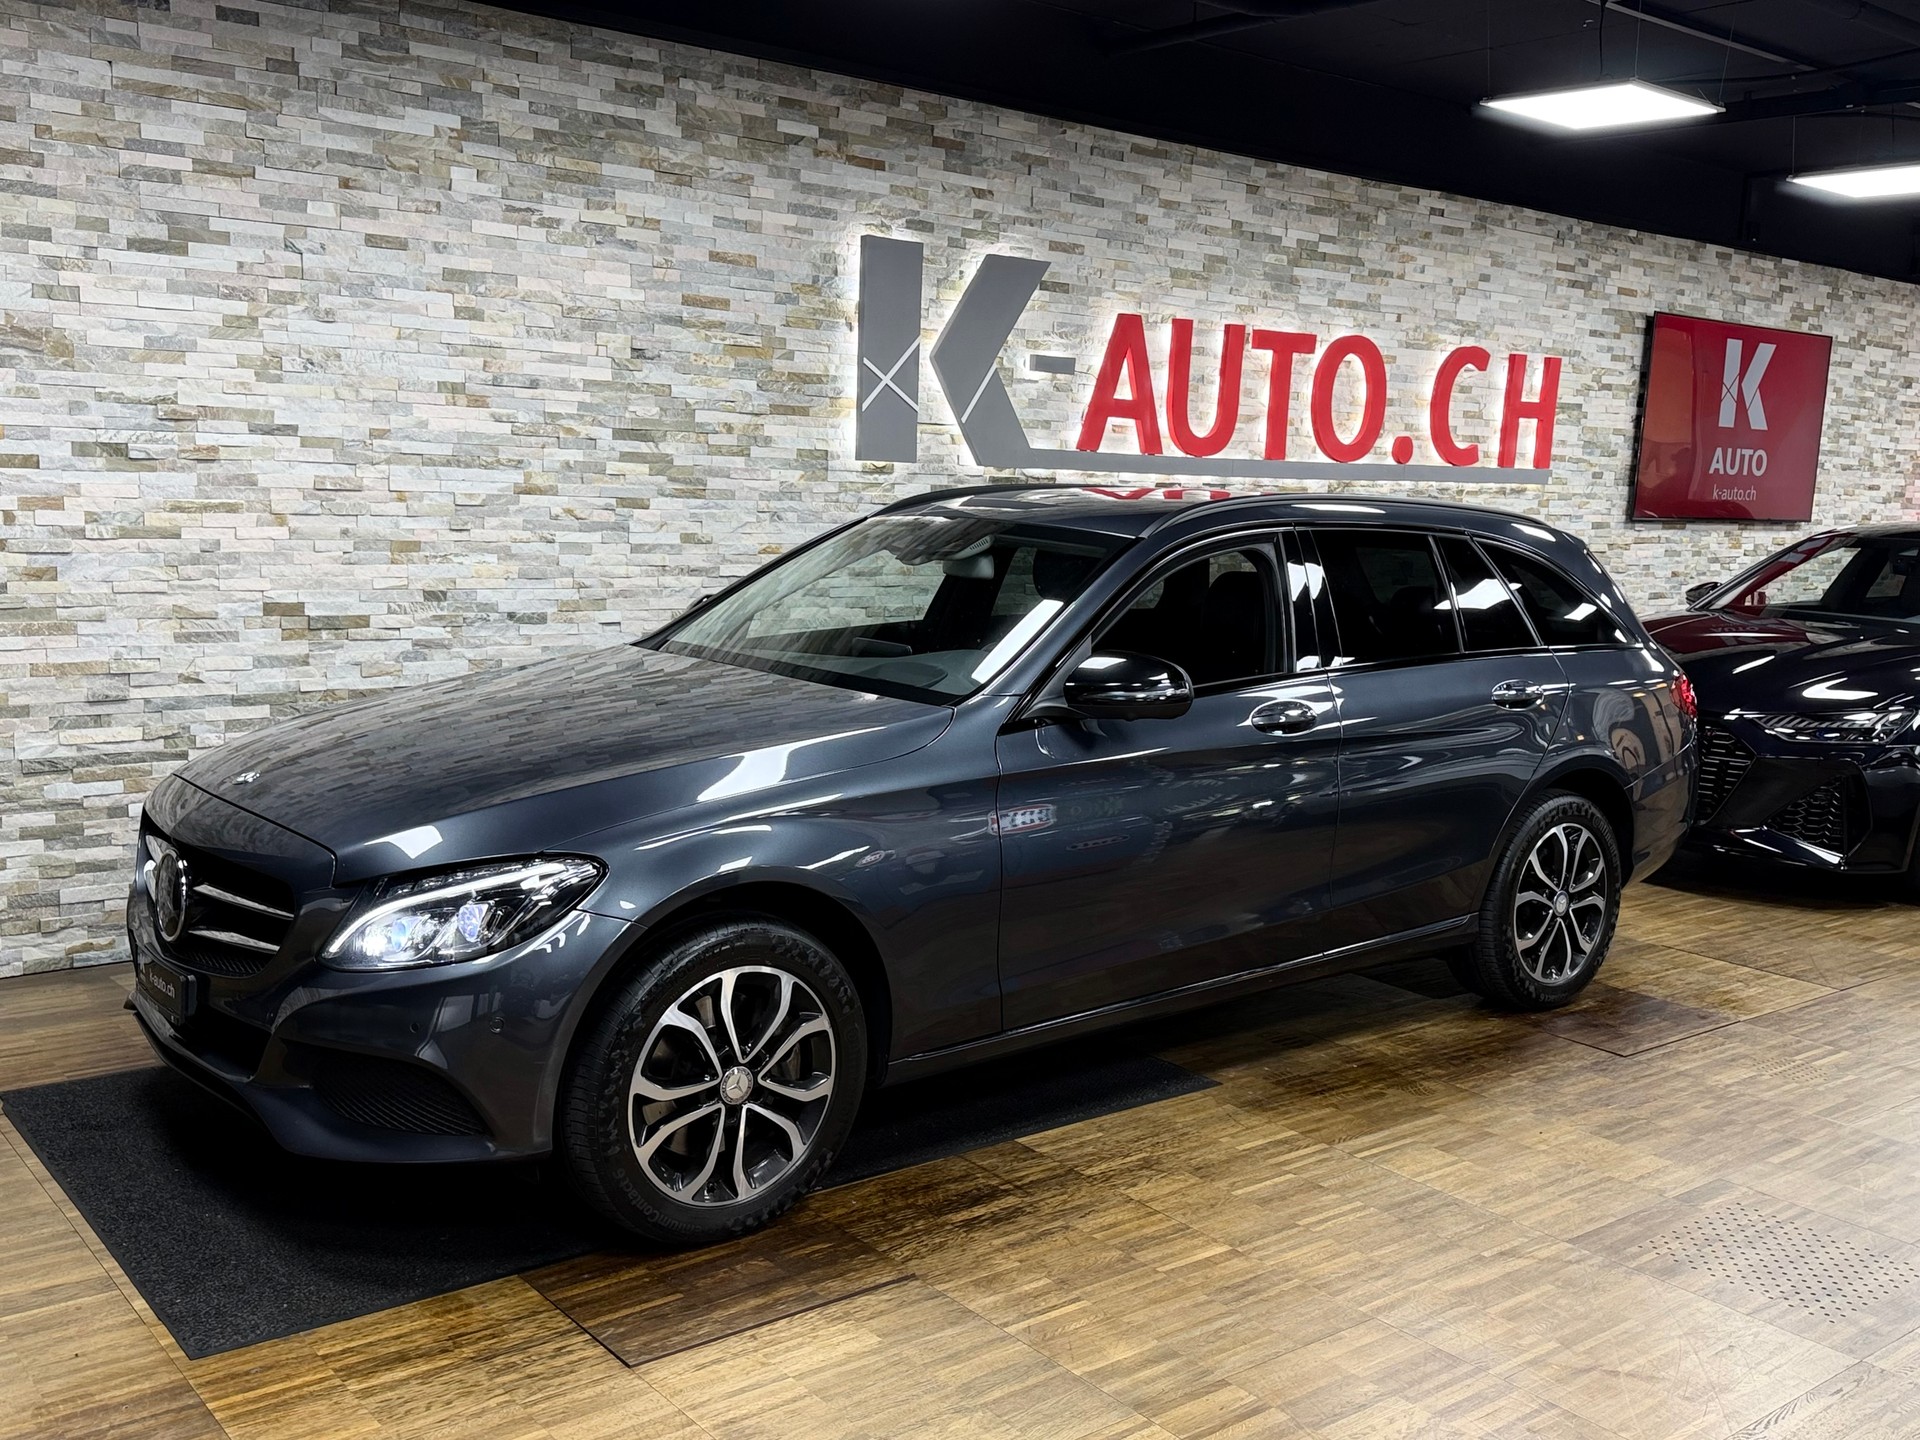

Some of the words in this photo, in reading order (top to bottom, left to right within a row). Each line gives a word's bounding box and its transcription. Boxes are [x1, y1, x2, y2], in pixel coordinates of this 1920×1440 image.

[1718, 338, 1777, 430] K
[1709, 447, 1767, 477] AUTO
[1712, 484, 1757, 501] k-auto.ch
